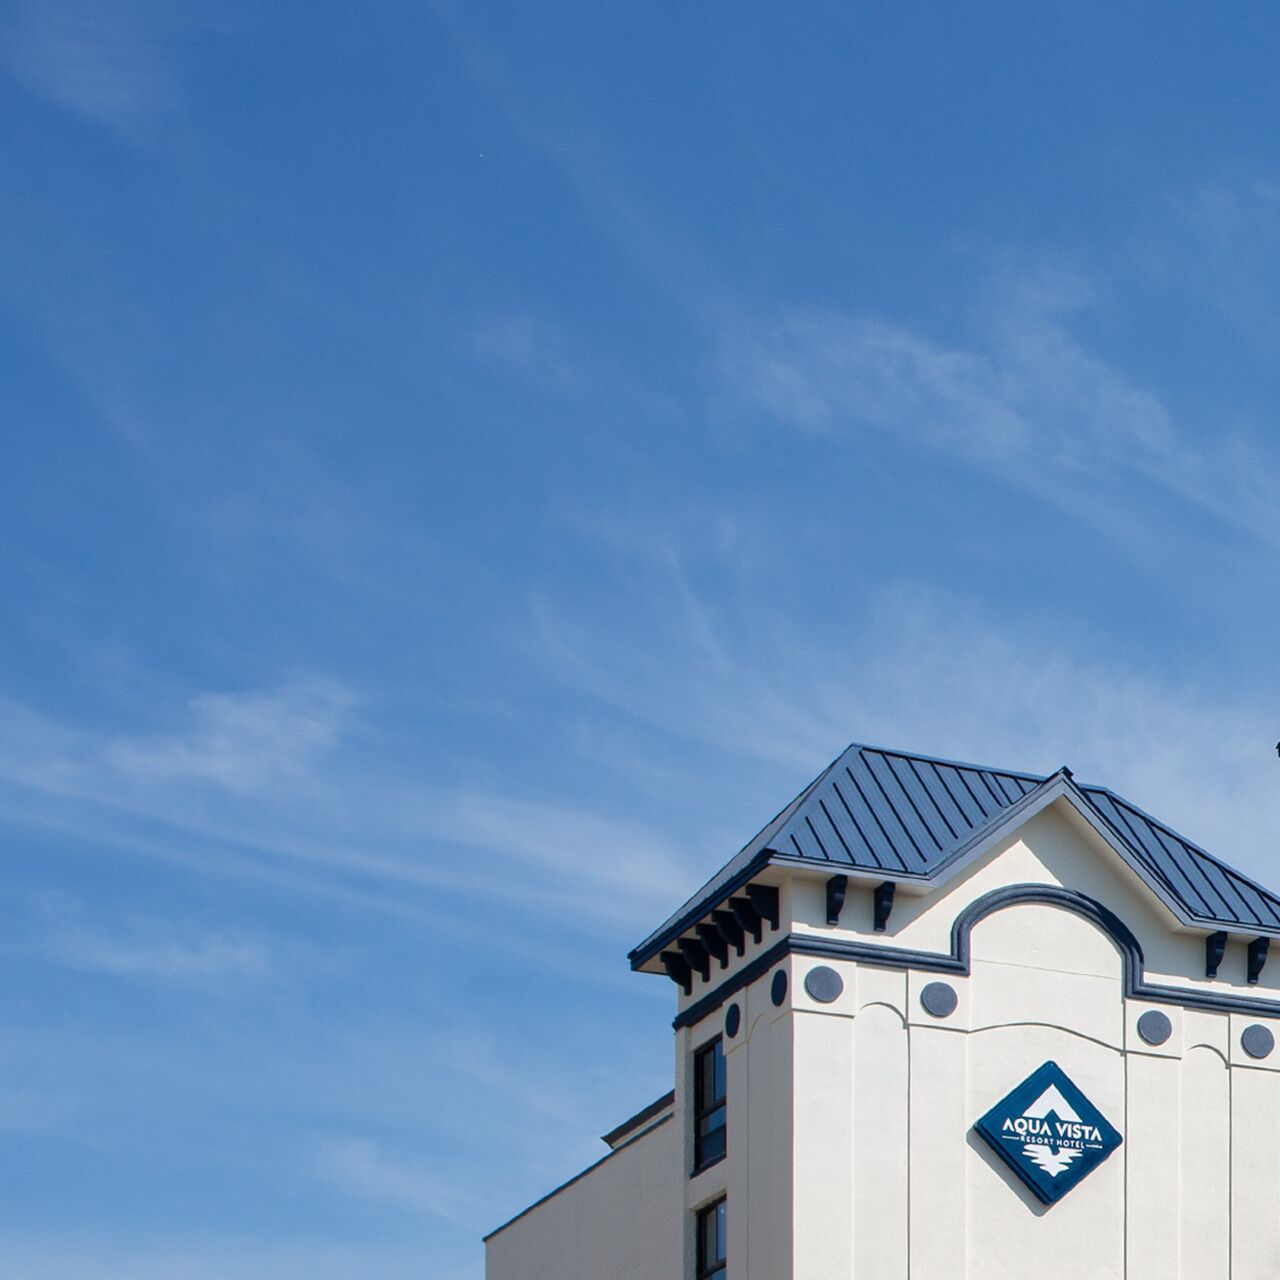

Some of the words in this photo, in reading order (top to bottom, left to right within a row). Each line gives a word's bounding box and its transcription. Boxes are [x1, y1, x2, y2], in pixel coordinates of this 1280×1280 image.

[1002, 1117, 1052, 1136] AQUA
[1055, 1122, 1103, 1141] VISTA
[1020, 1136, 1053, 1145] RESORT
[1056, 1139, 1085, 1149] HOTEL
